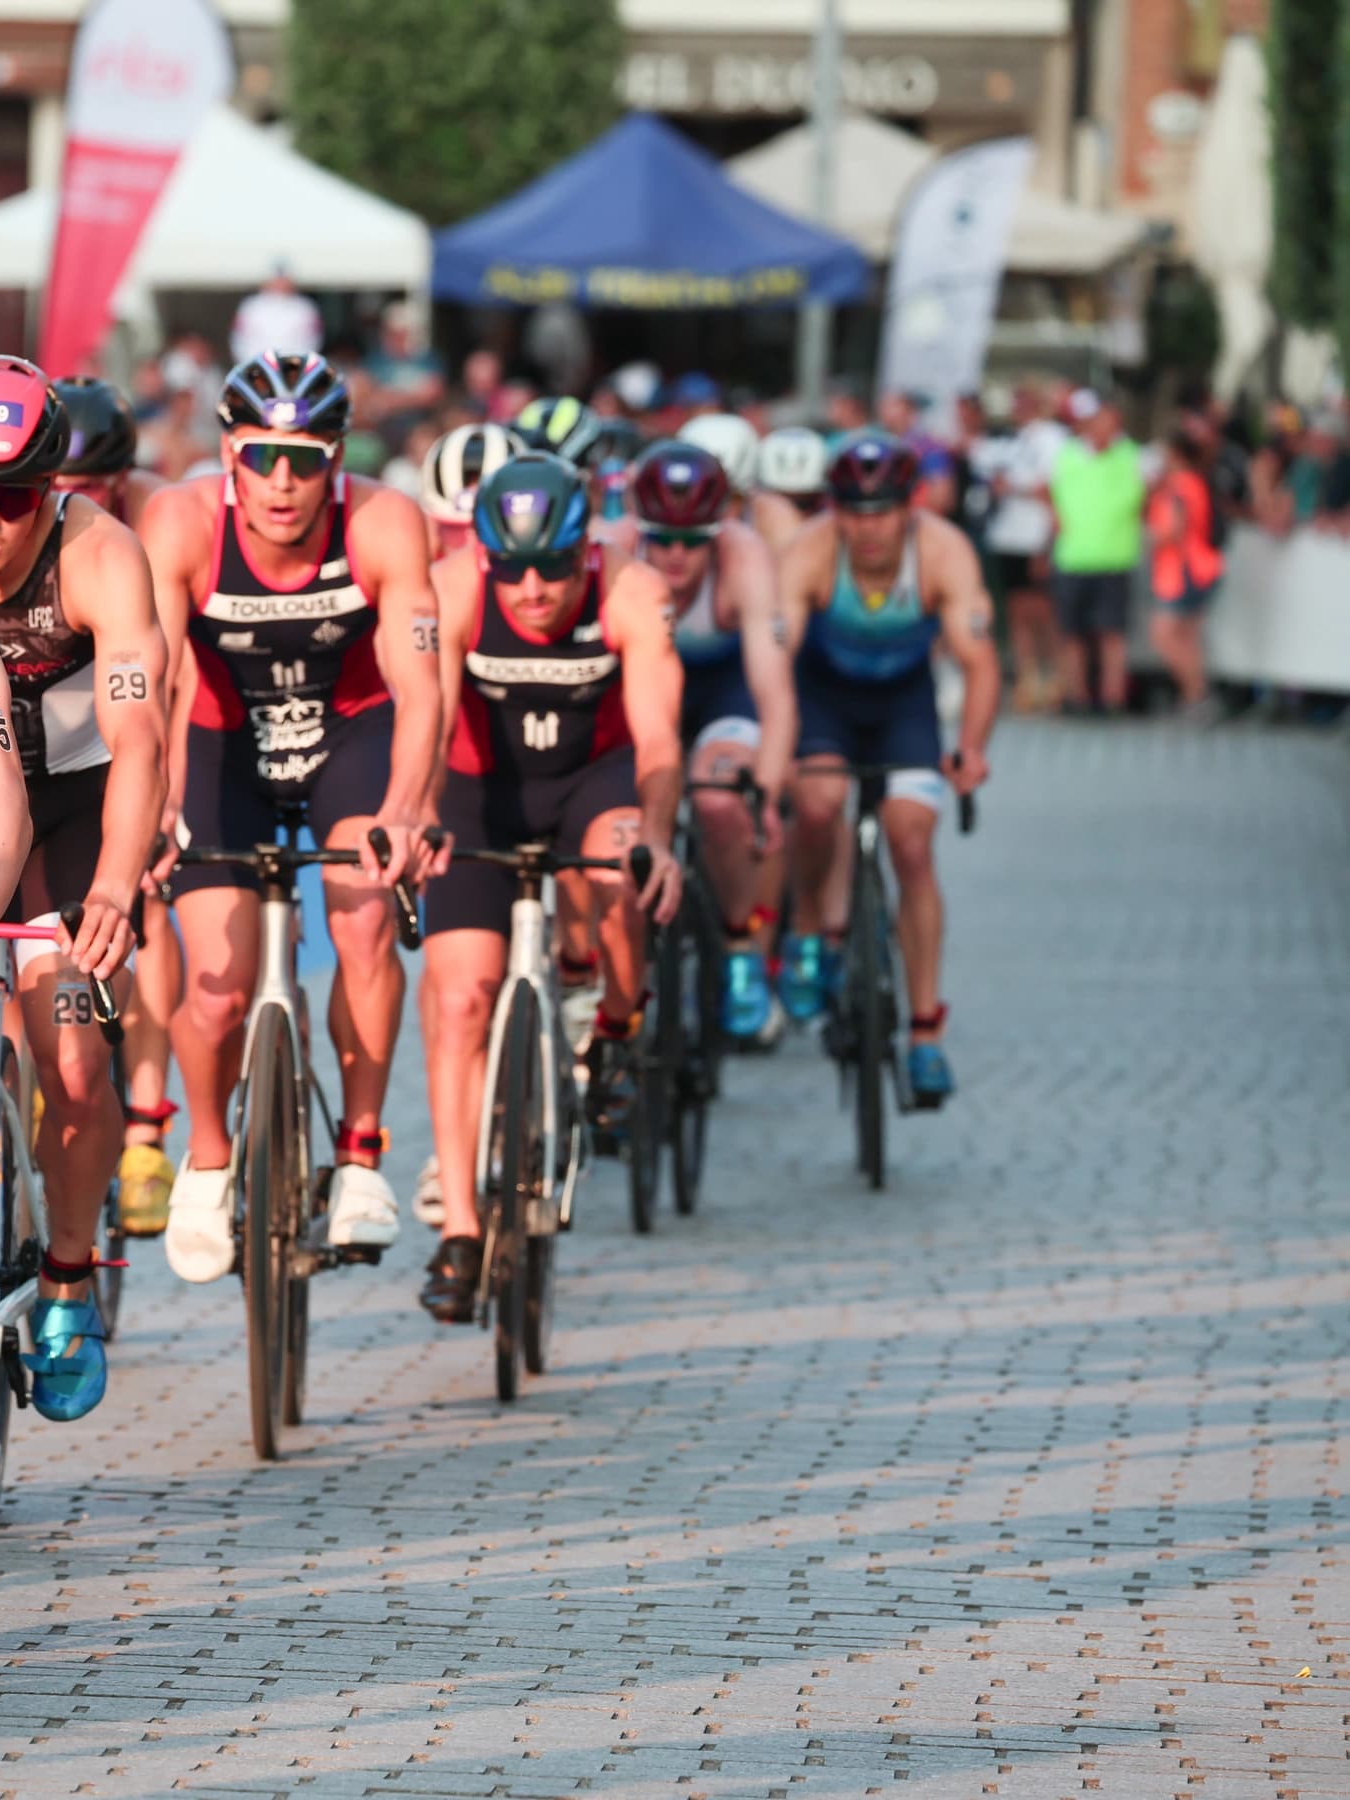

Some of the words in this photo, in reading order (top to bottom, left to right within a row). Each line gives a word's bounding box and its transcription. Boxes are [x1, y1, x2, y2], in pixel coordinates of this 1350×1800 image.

[230, 596, 339, 617] TOULOUSE
[108, 672, 147, 701] 29
[54, 992, 91, 1025] 29
